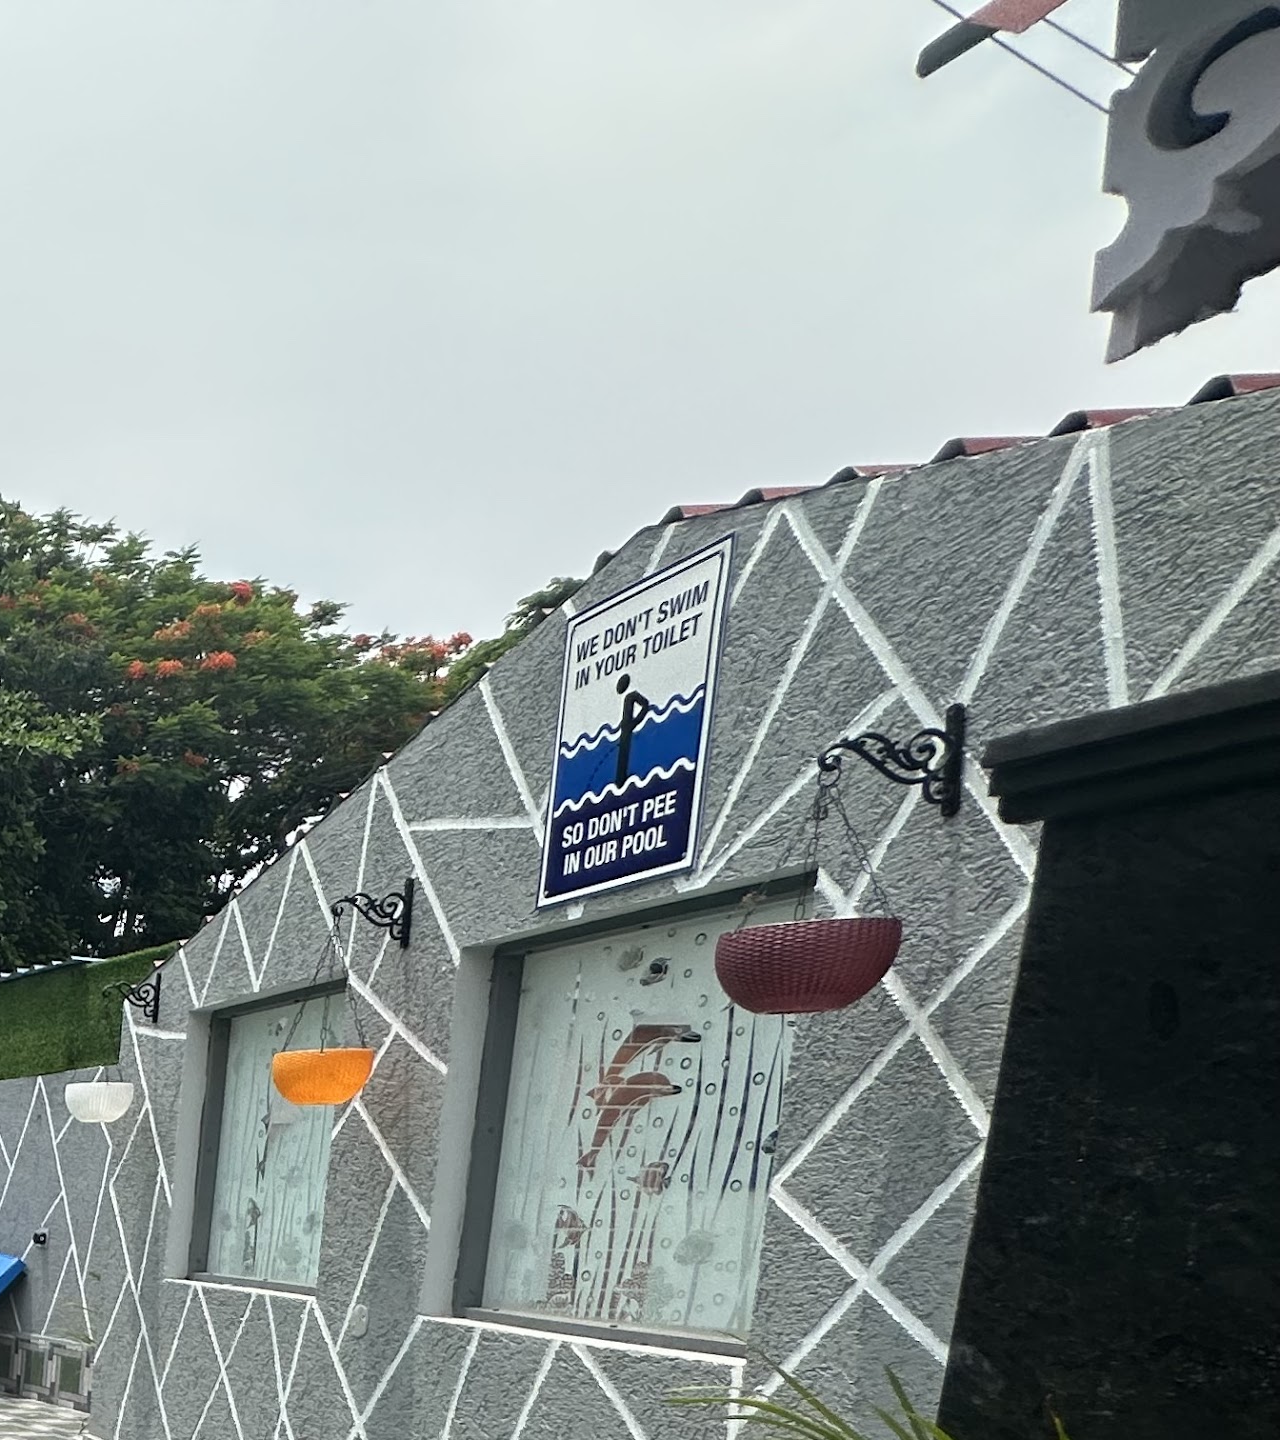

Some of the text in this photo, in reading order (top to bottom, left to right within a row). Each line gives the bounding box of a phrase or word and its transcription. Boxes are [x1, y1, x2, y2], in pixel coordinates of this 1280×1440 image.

[575, 612, 703, 691] IN YOUR TOILET
[576, 580, 709, 663] WE DON'T SWIM
[561, 790, 677, 848] SO DON'T PEE
[563, 824, 668, 876] IN OUR POOL
